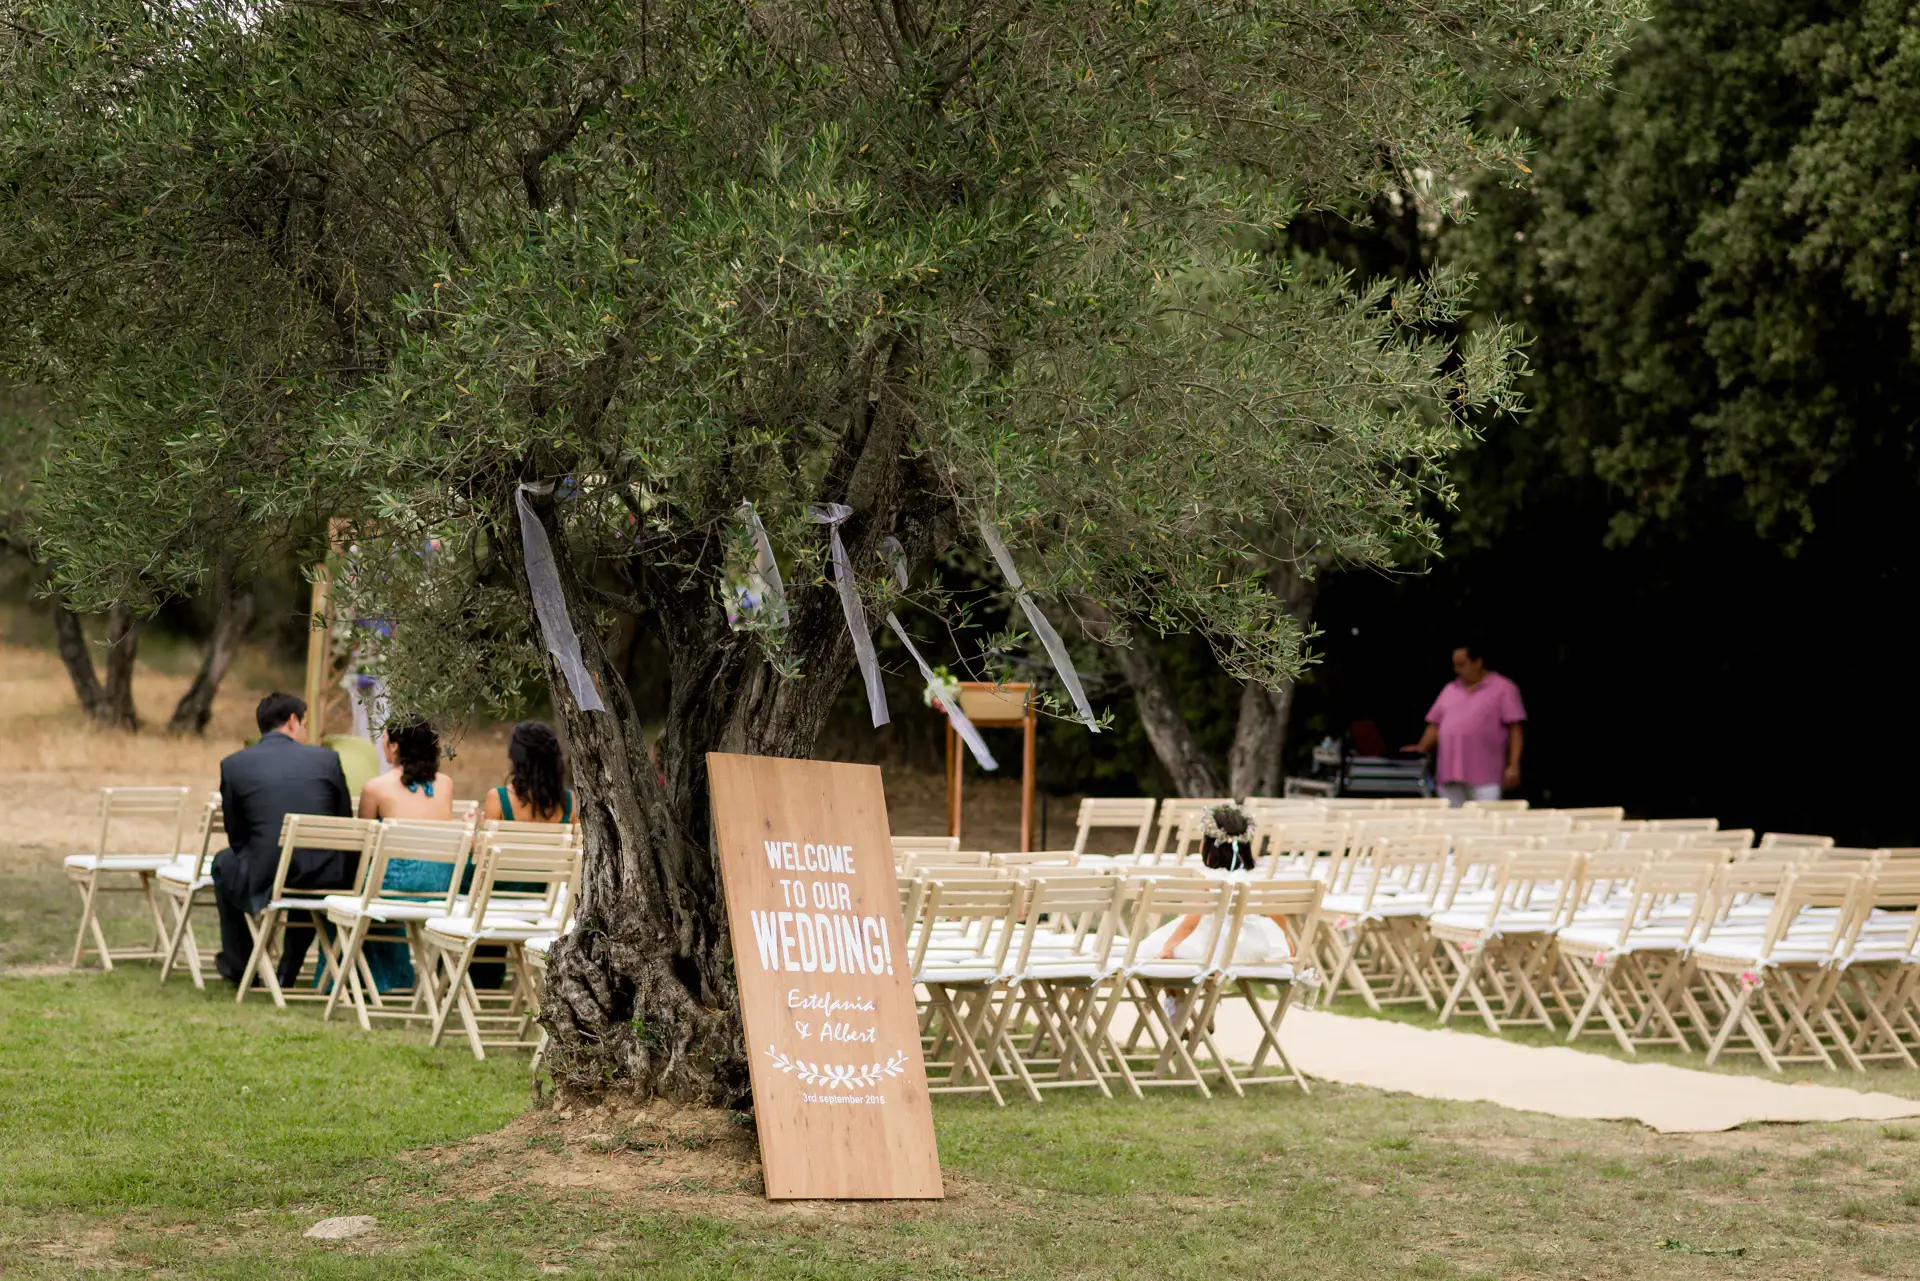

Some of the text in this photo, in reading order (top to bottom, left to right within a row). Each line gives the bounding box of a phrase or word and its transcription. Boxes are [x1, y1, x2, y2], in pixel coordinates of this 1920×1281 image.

[764, 841, 856, 874] WELCOME
[780, 880, 852, 911] TO OUR
[751, 910, 893, 976] WEDDING!
[788, 989, 876, 1017] Estefania
[795, 1020, 876, 1043] & Albert
[802, 1093, 885, 1105] 3rd september 2016
